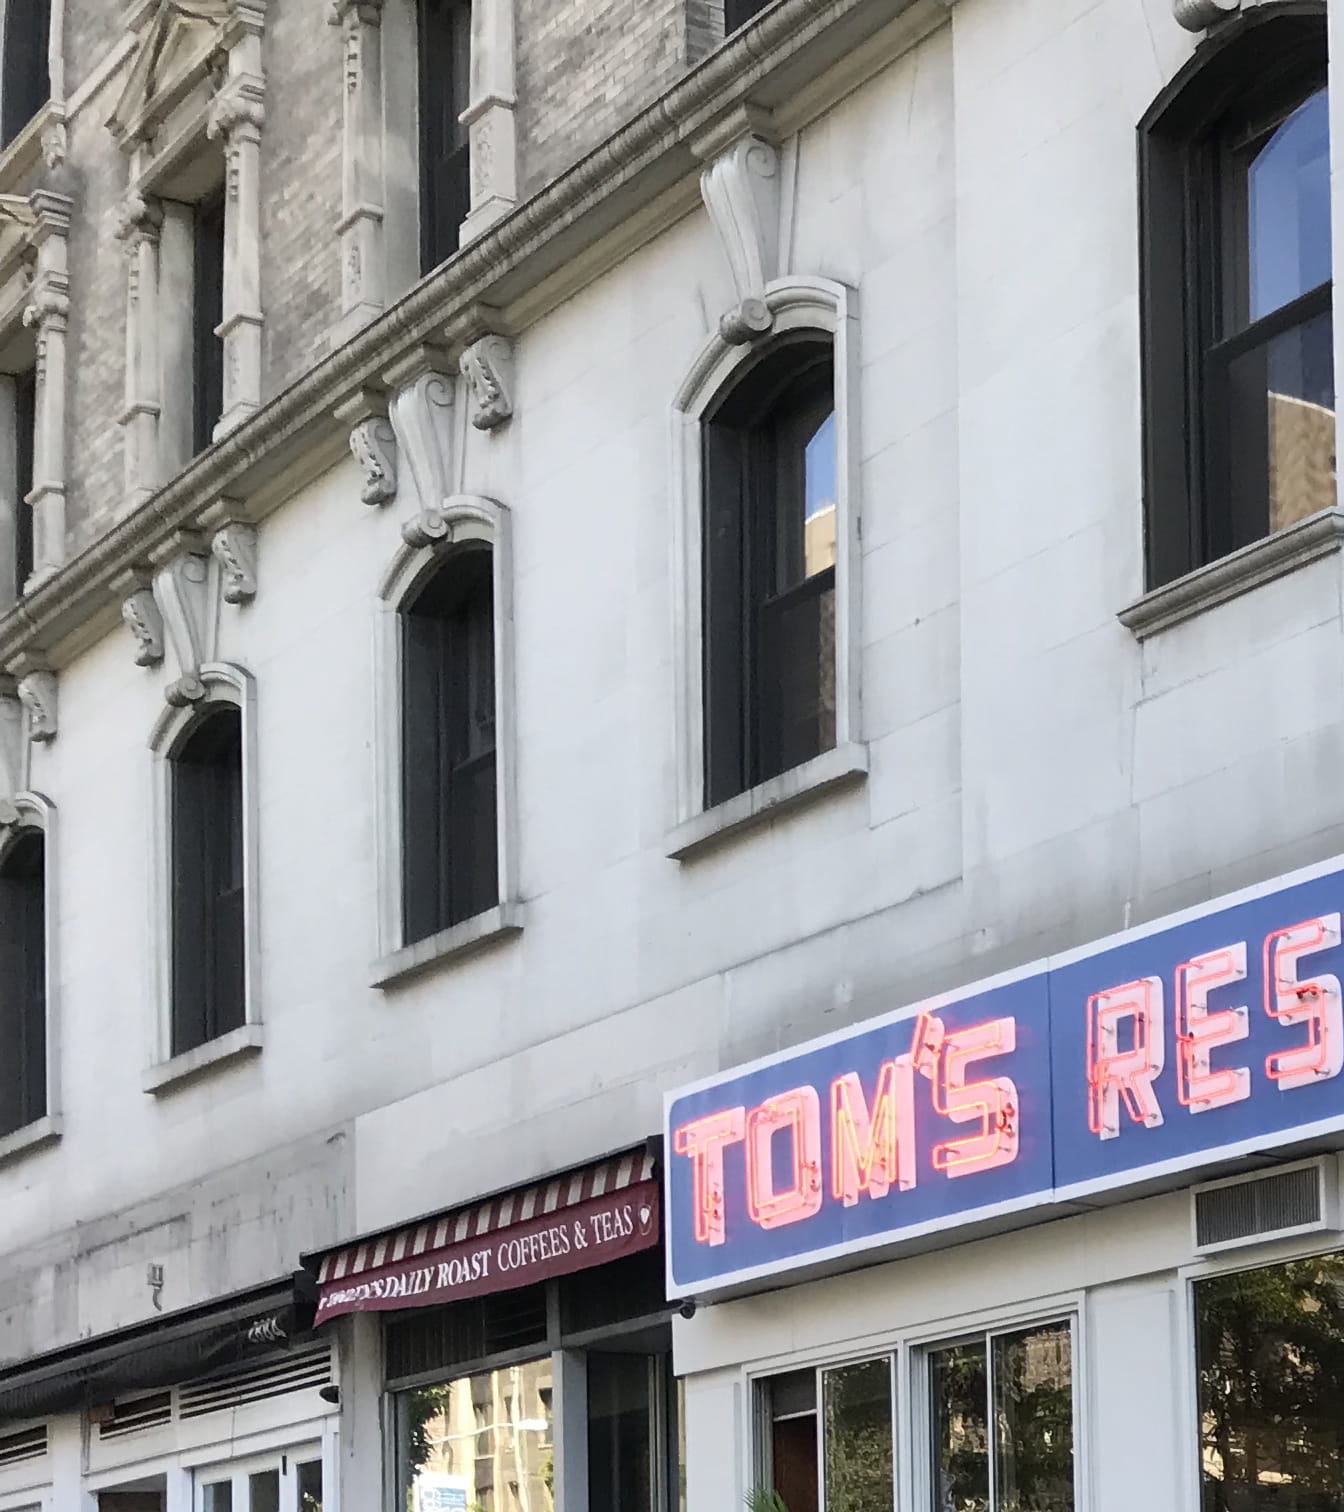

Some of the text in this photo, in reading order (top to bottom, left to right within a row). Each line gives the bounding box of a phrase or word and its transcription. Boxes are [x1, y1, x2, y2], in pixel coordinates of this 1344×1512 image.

[675, 1009, 1020, 1247] TOM'S
[383, 1266, 435, 1298] DAILY
[436, 1249, 492, 1289] ROAST
[497, 1224, 570, 1272] COFFEES
[574, 1220, 589, 1250] &
[590, 1204, 634, 1244] TEAS
